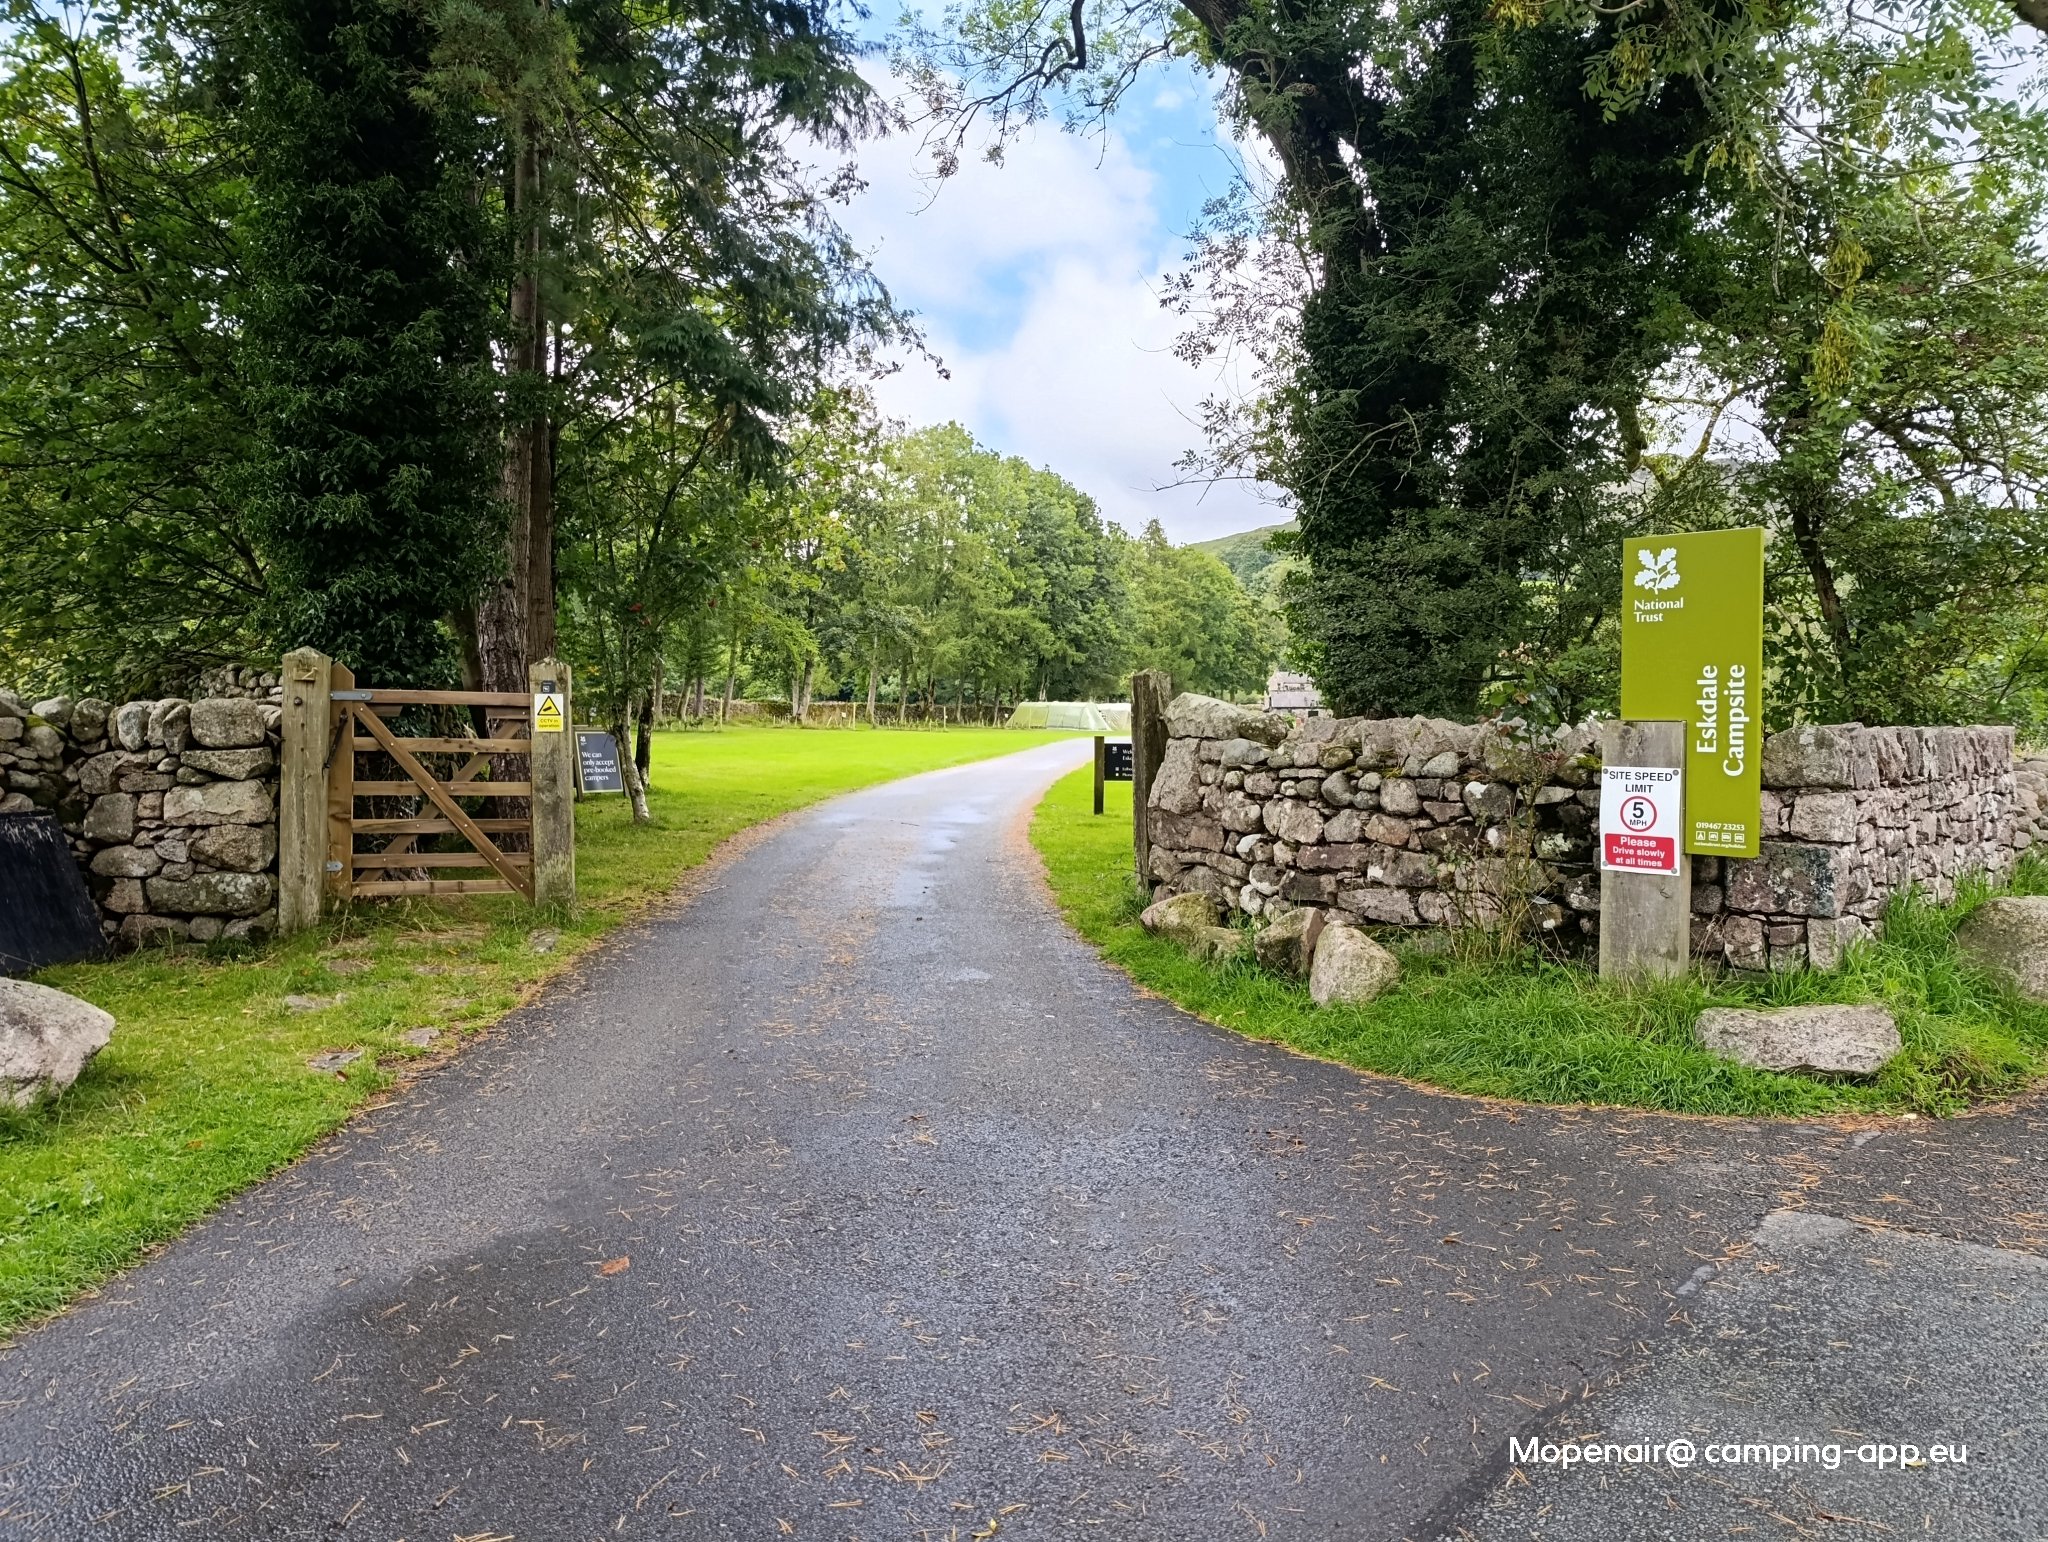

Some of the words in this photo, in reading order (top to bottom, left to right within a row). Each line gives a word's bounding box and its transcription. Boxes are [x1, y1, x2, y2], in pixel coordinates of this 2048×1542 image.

[1633, 597, 1684, 610] National
[1633, 611, 1664, 622] Trust
[1696, 665, 1718, 753] Eskdale
[1723, 664, 1750, 777] Campsite
[582, 759, 595, 767] only
[583, 766, 617, 775] pre-booked
[1609, 770, 1631, 780] SITE
[1634, 772, 1673, 782] SPEED
[584, 775, 609, 783] campers
[1625, 784, 1654, 793] LIMIT
[1632, 801, 1645, 819] 5
[1629, 819, 1647, 827] MPH
[1695, 821, 1722, 830] 019467
[1722, 823, 1745, 831] 23253
[1620, 836, 1657, 848] Please
[1612, 846, 1635, 856] Drive
[1636, 848, 1665, 859] slowly
[1625, 857, 1636, 865] all
[1637, 859, 1663, 868] times
